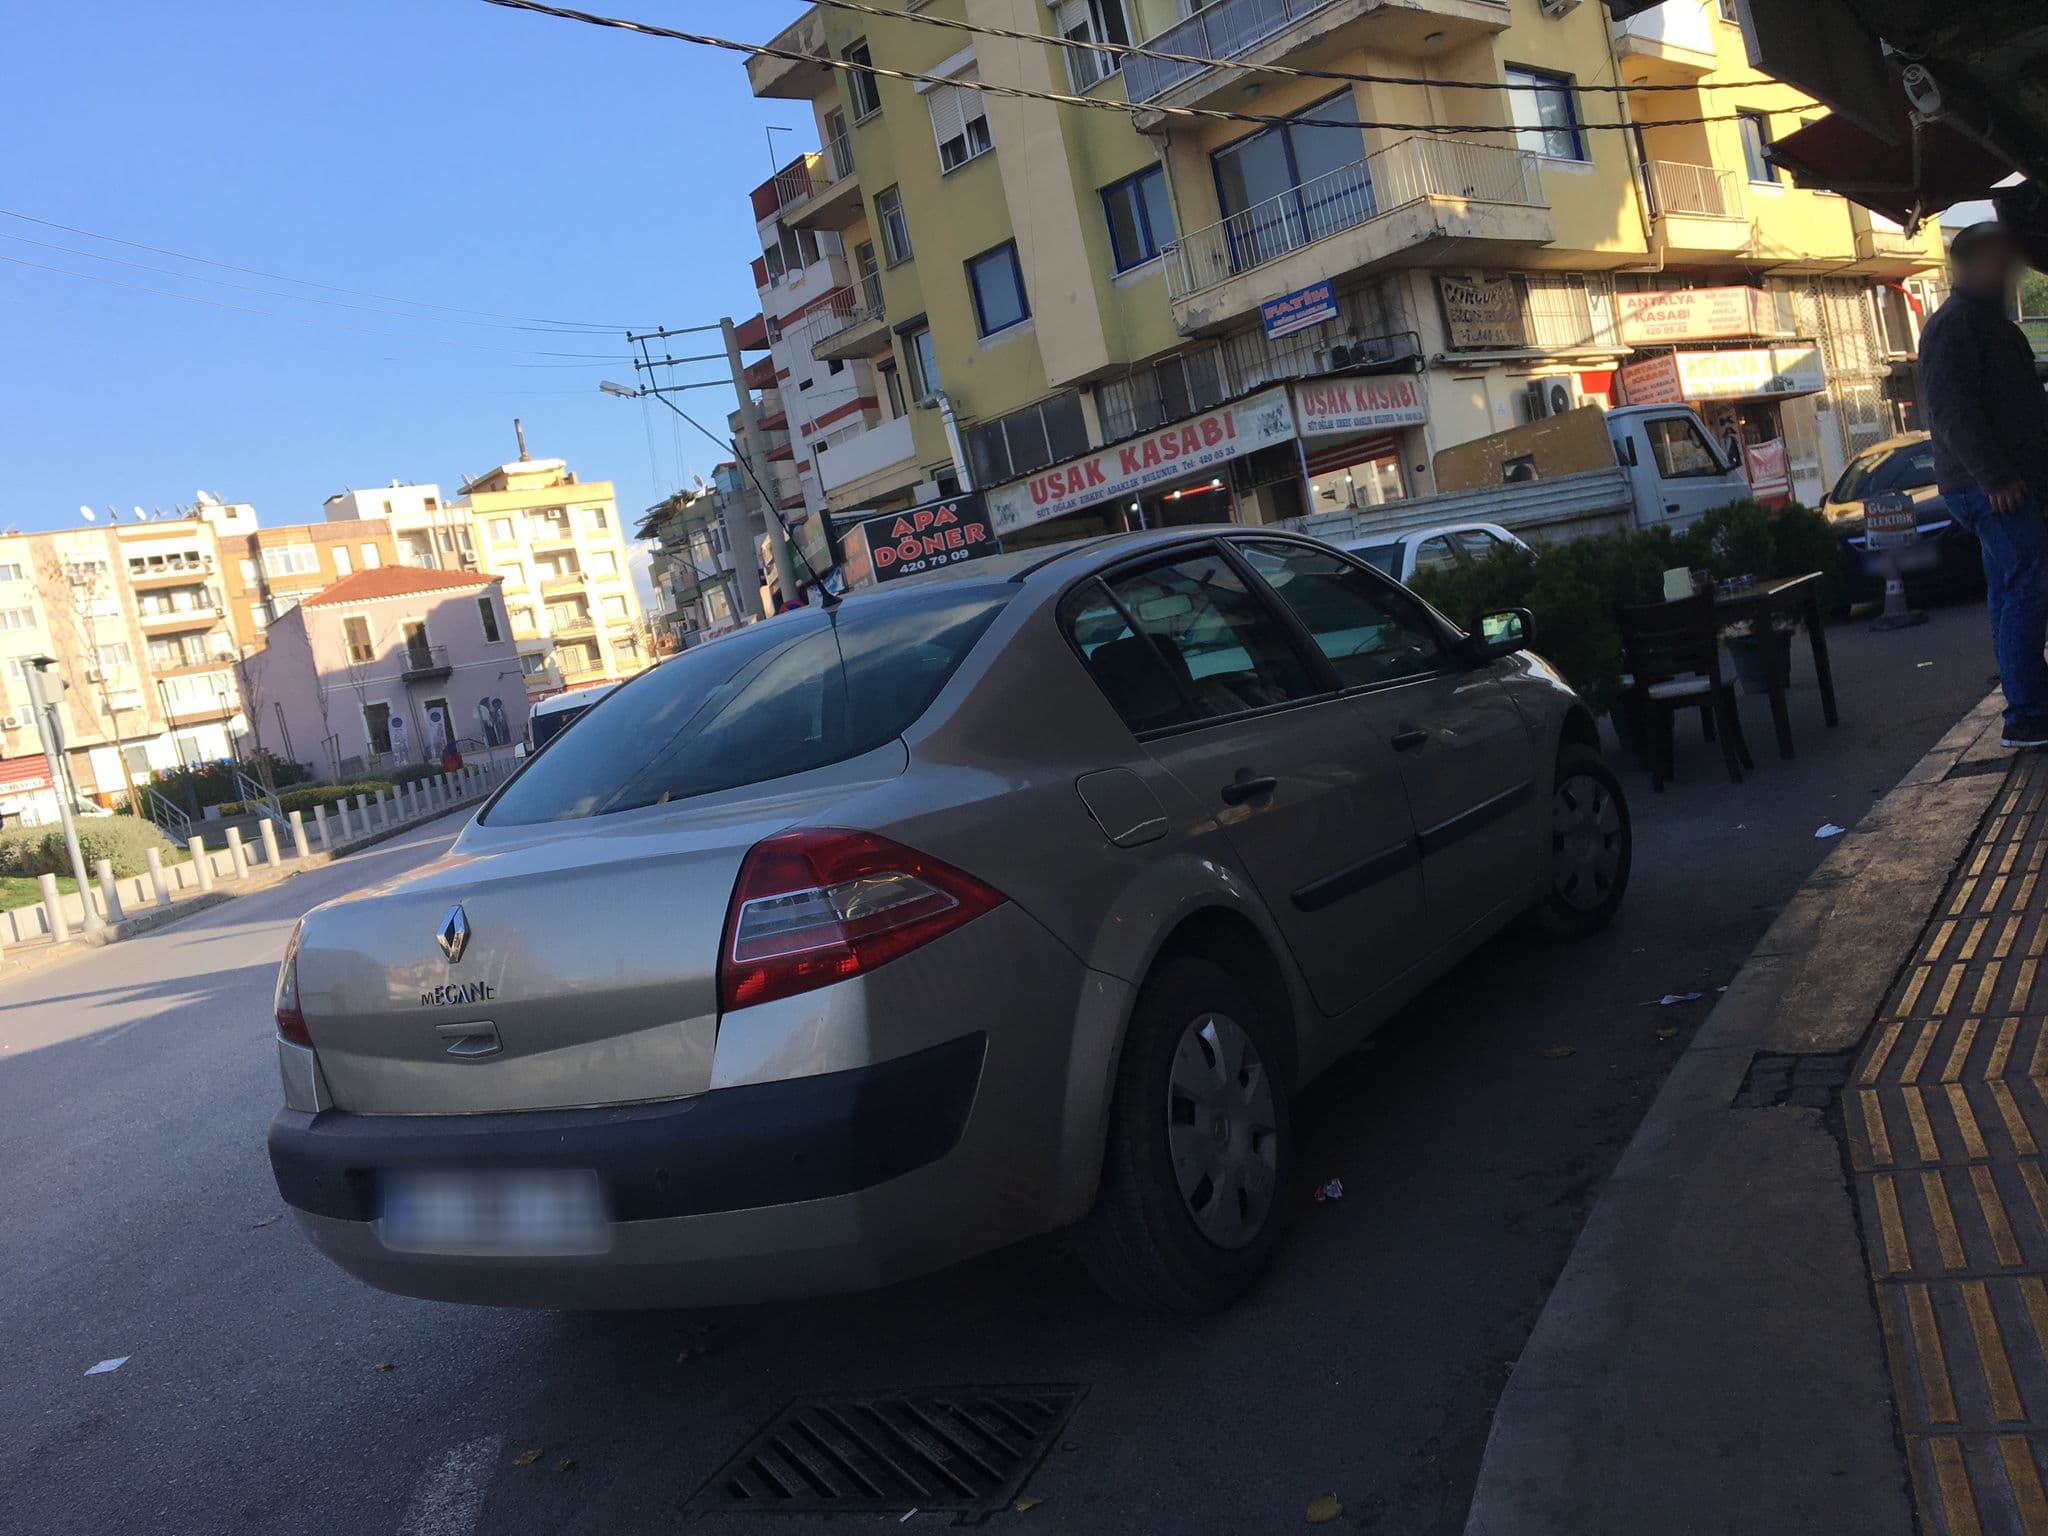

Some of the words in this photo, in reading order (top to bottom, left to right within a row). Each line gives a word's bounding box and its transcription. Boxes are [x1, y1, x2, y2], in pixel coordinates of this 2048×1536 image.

[1626, 294, 1695, 309] ANTALYA
[1633, 308, 1690, 324] KASABI
[1645, 327, 1661, 336] 420
[1353, 381, 1418, 412] KASABI
[1119, 411, 1237, 475] KASABI
[1199, 453, 1213, 465] 420
[890, 505, 959, 539] APA
[873, 522, 987, 568] DÖNER
[899, 560, 926, 574] 420
[929, 553, 948, 567] 79
[951, 549, 970, 561] 09
